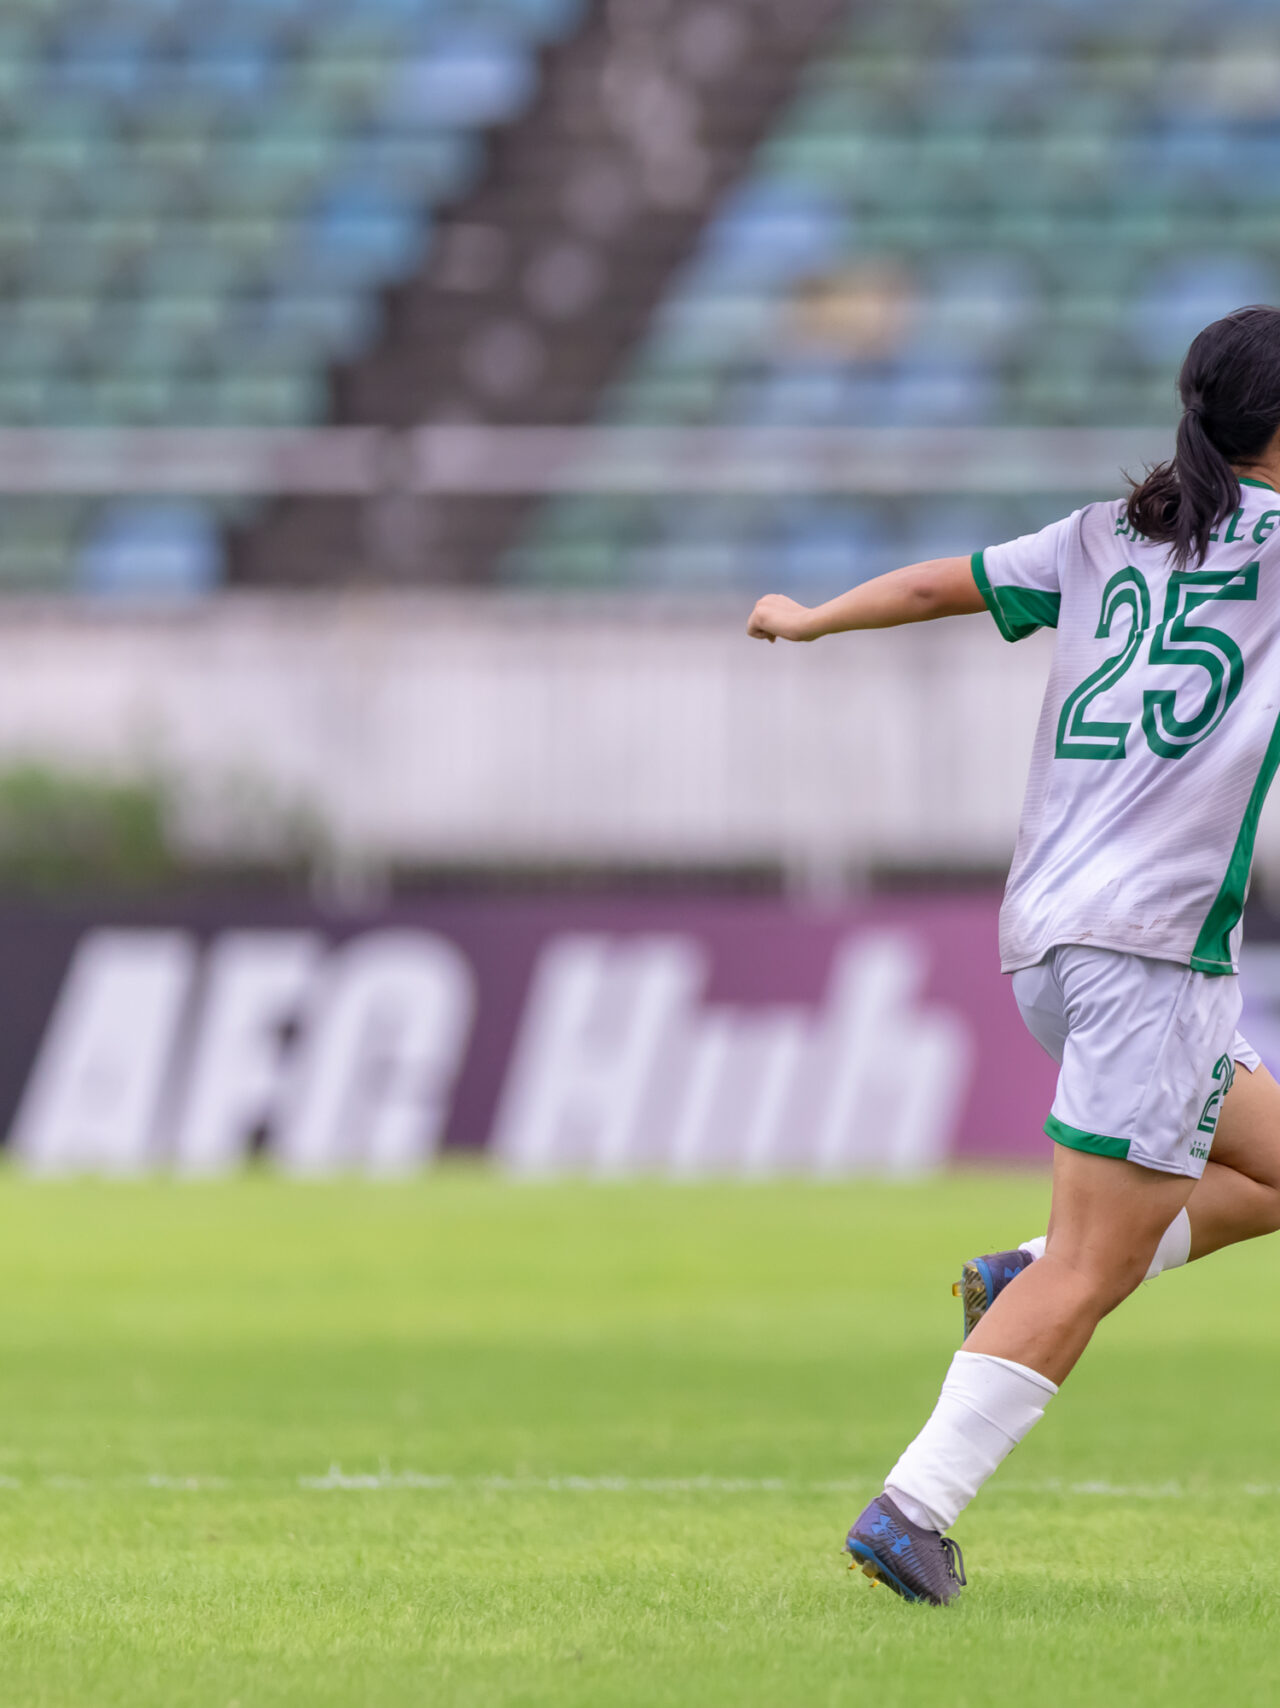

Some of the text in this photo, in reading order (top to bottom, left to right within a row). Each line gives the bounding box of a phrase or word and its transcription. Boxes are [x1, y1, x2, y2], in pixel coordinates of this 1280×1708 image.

[1054, 561, 1260, 760] 25
[8, 928, 972, 1174] AFC Hub
